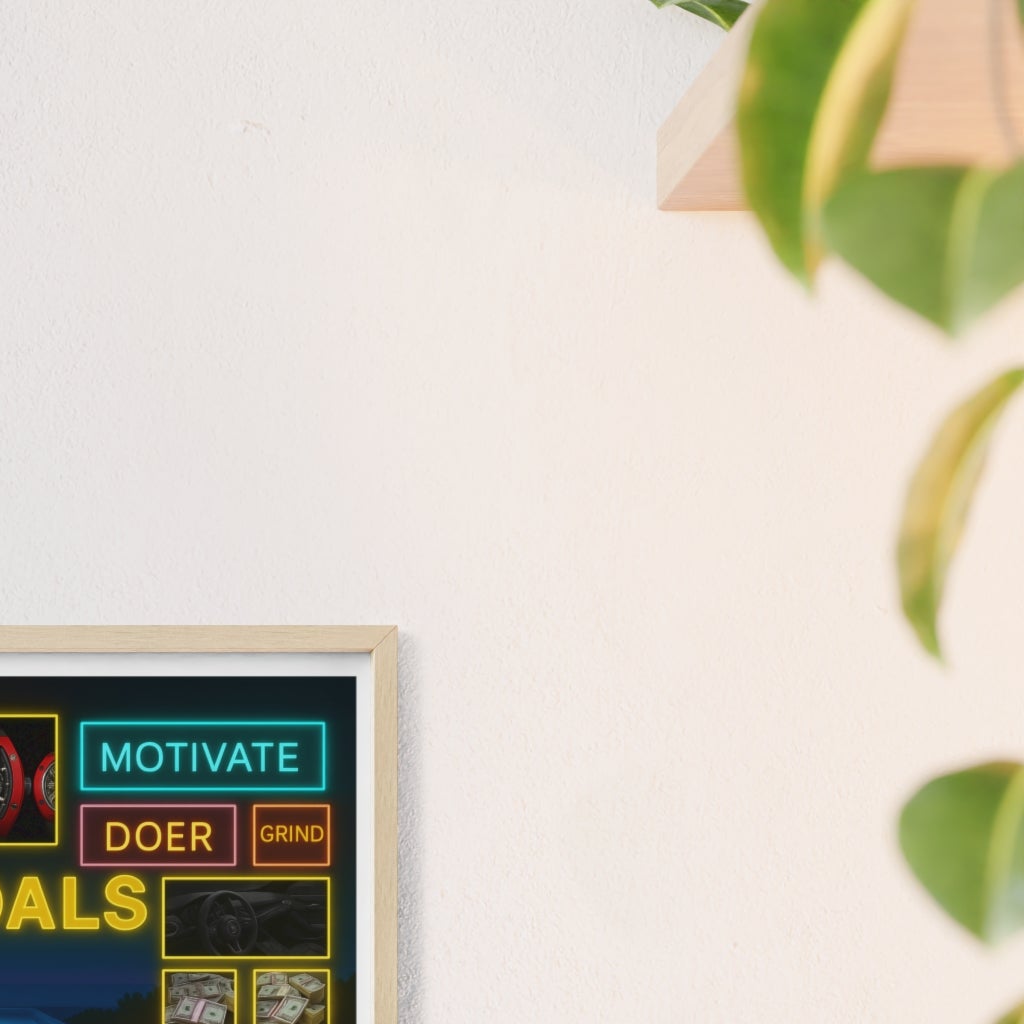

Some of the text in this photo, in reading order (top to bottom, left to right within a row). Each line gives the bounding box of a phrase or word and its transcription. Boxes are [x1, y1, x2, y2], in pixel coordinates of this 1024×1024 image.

[101, 741, 300, 773] MOTIVATE
[105, 821, 213, 852] DOER
[259, 824, 325, 844] GRIND
